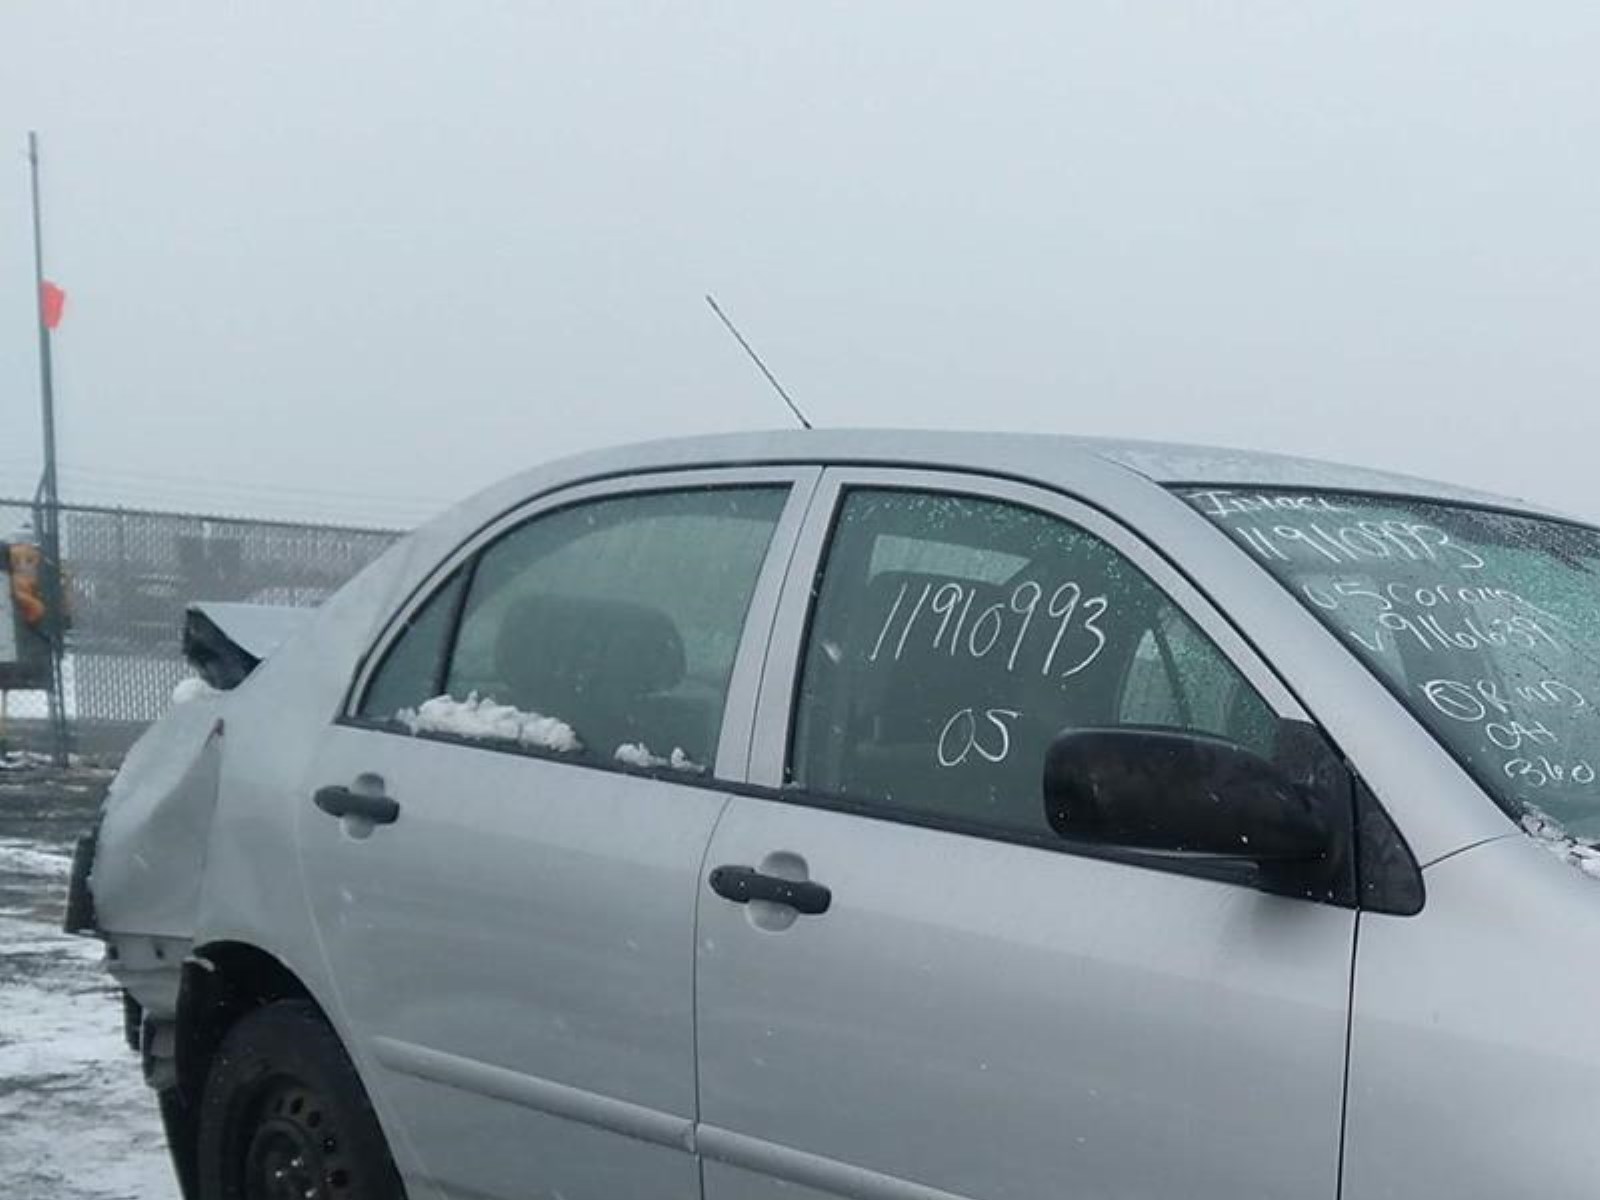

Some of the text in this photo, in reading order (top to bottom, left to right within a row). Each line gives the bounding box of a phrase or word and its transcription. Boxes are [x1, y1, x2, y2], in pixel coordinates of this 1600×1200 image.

[1234, 519, 1485, 569] 11910993
[868, 580, 1109, 677] 11910993
[937, 707, 1020, 767] 05
